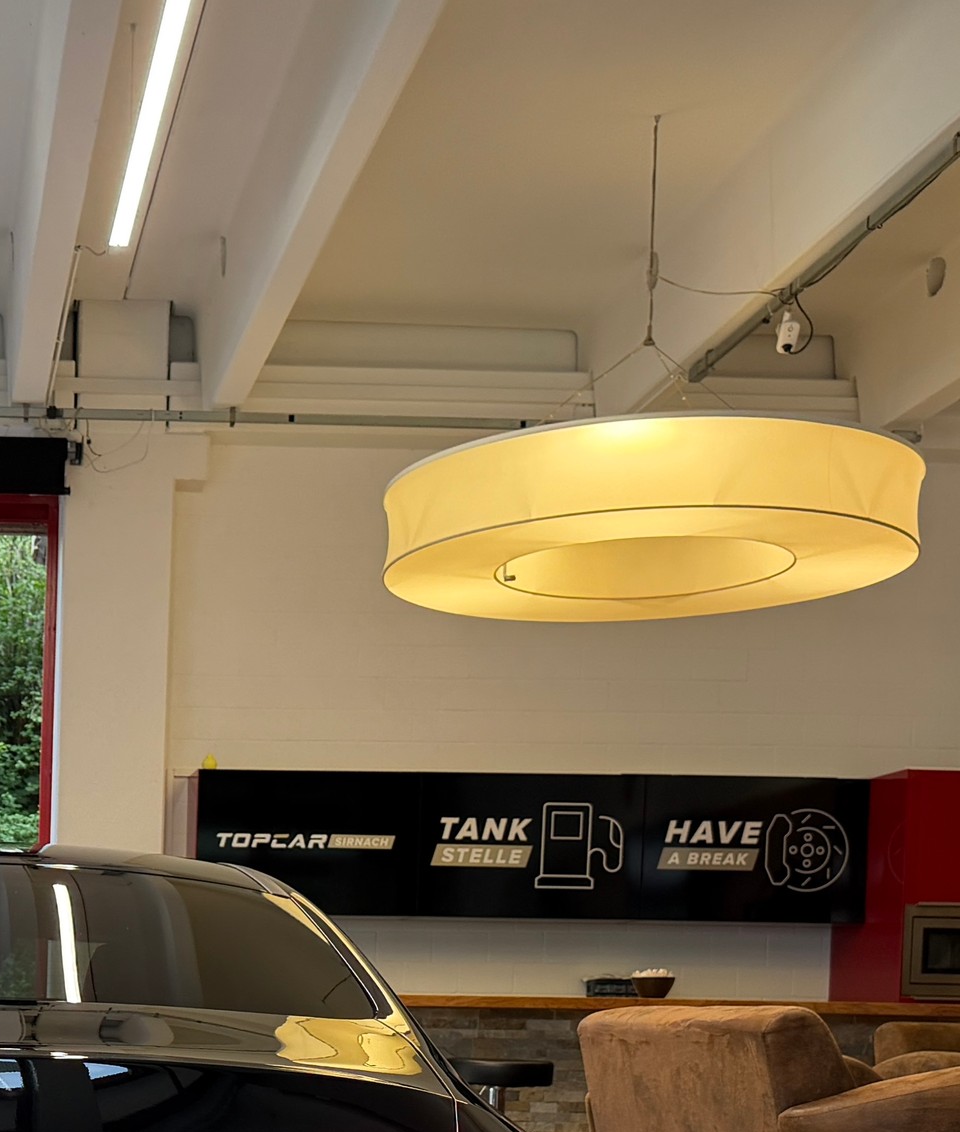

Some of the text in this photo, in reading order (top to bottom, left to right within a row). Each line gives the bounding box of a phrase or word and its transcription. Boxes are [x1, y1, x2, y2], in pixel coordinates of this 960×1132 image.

[440, 816, 533, 841] TANK
[664, 819, 763, 845] HAVE
[216, 832, 389, 849] TOPCAR SIRNACH
[441, 847, 523, 864] STELLE
[666, 851, 749, 866] A BREAK
